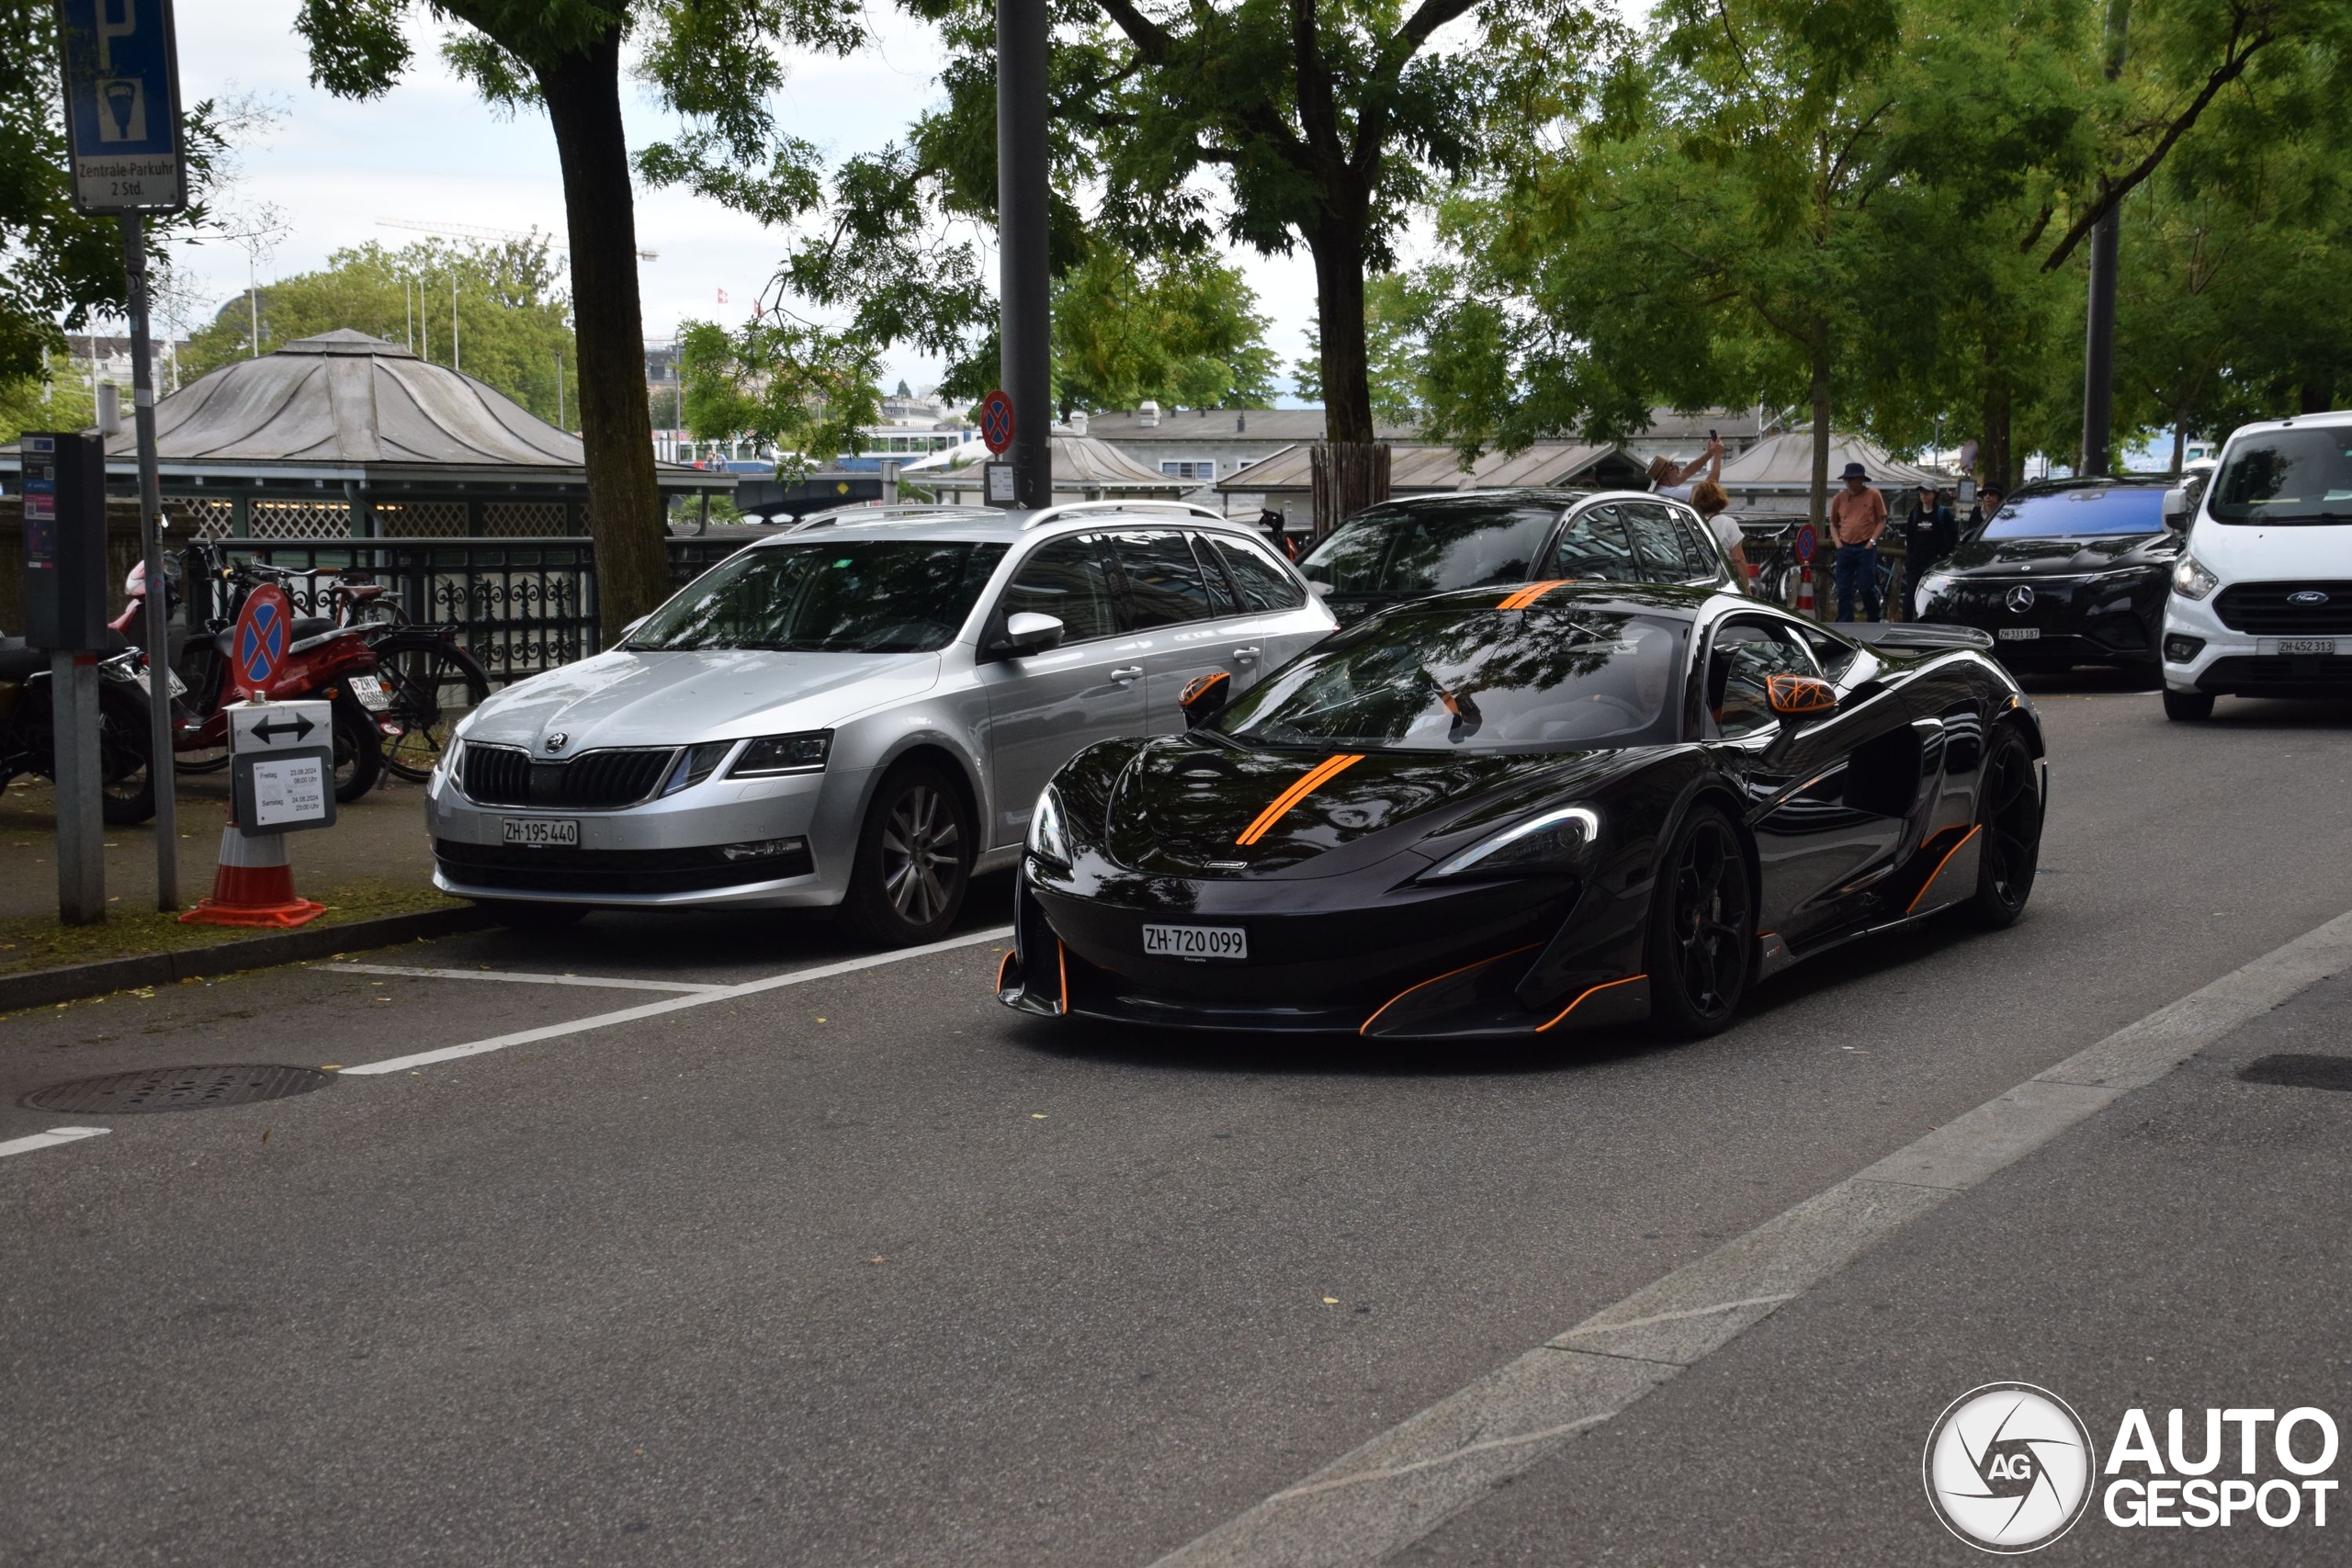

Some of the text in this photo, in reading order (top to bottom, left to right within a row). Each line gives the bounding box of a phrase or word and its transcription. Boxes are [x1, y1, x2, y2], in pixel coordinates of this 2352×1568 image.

[80, 162, 175, 178] Zentrale Parkuhr
[111, 182, 144, 196] 2 Std.
[2314, 641, 2333, 651] 313
[357, 678, 372, 690] ZH
[262, 799, 284, 807] Samstag
[550, 824, 575, 842] 440
[1209, 931, 1244, 954] 099
